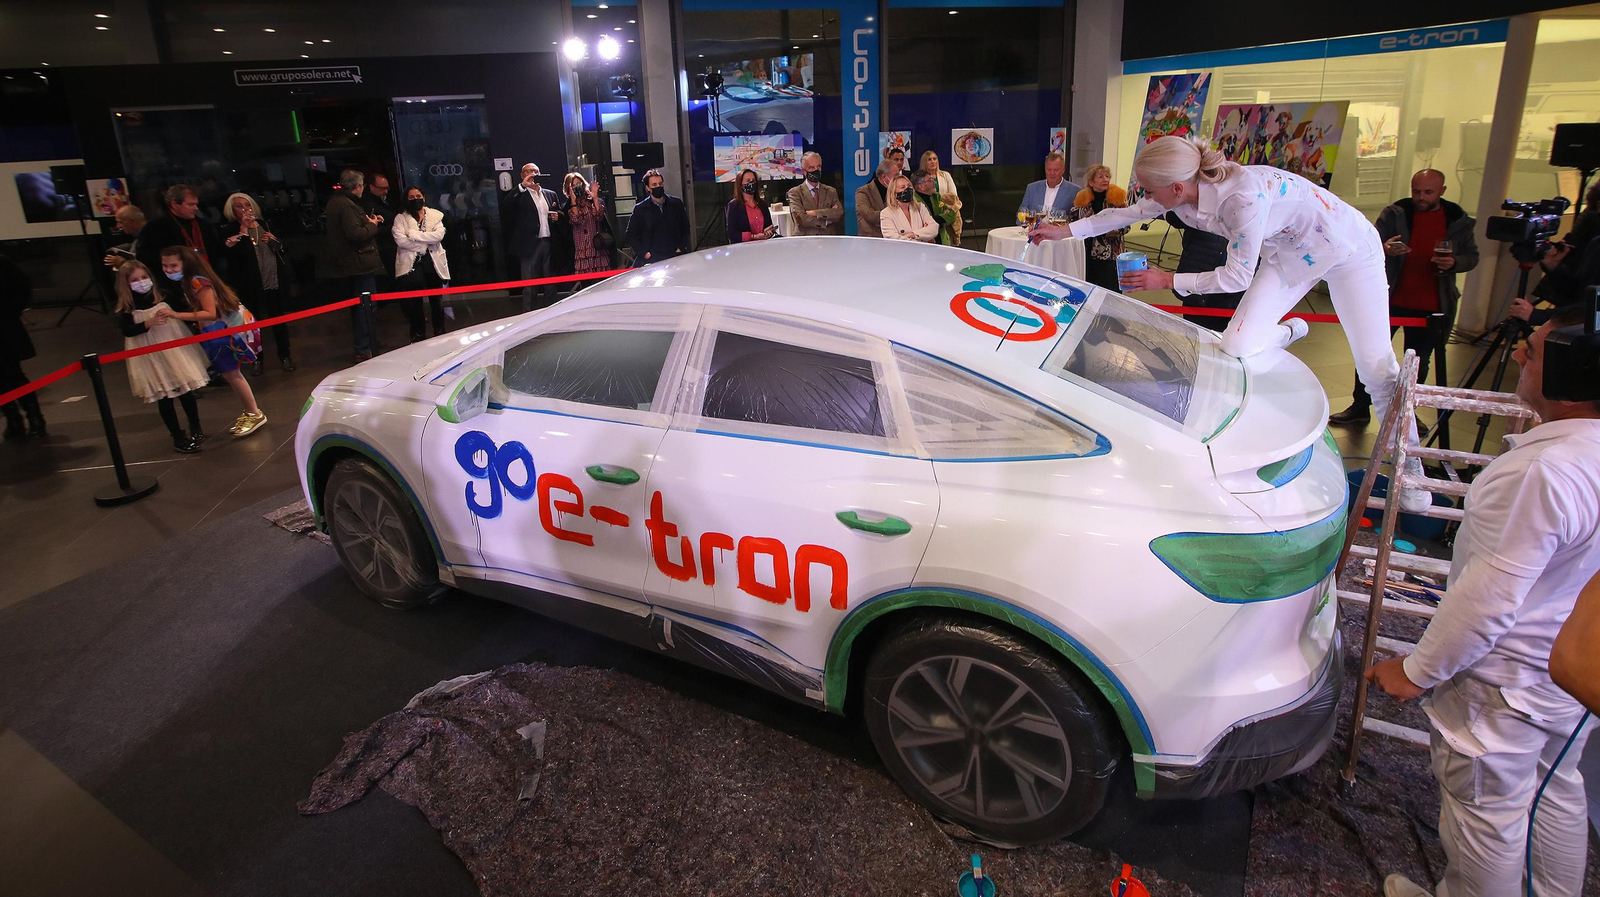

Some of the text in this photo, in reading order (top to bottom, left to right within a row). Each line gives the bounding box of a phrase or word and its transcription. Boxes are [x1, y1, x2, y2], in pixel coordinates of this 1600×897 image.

[241, 69, 352, 82] www.gruposolera.net
[1380, 28, 1479, 49] e-tron
[853, 28, 870, 177] e-tron
[454, 430, 848, 612] go e-tron
